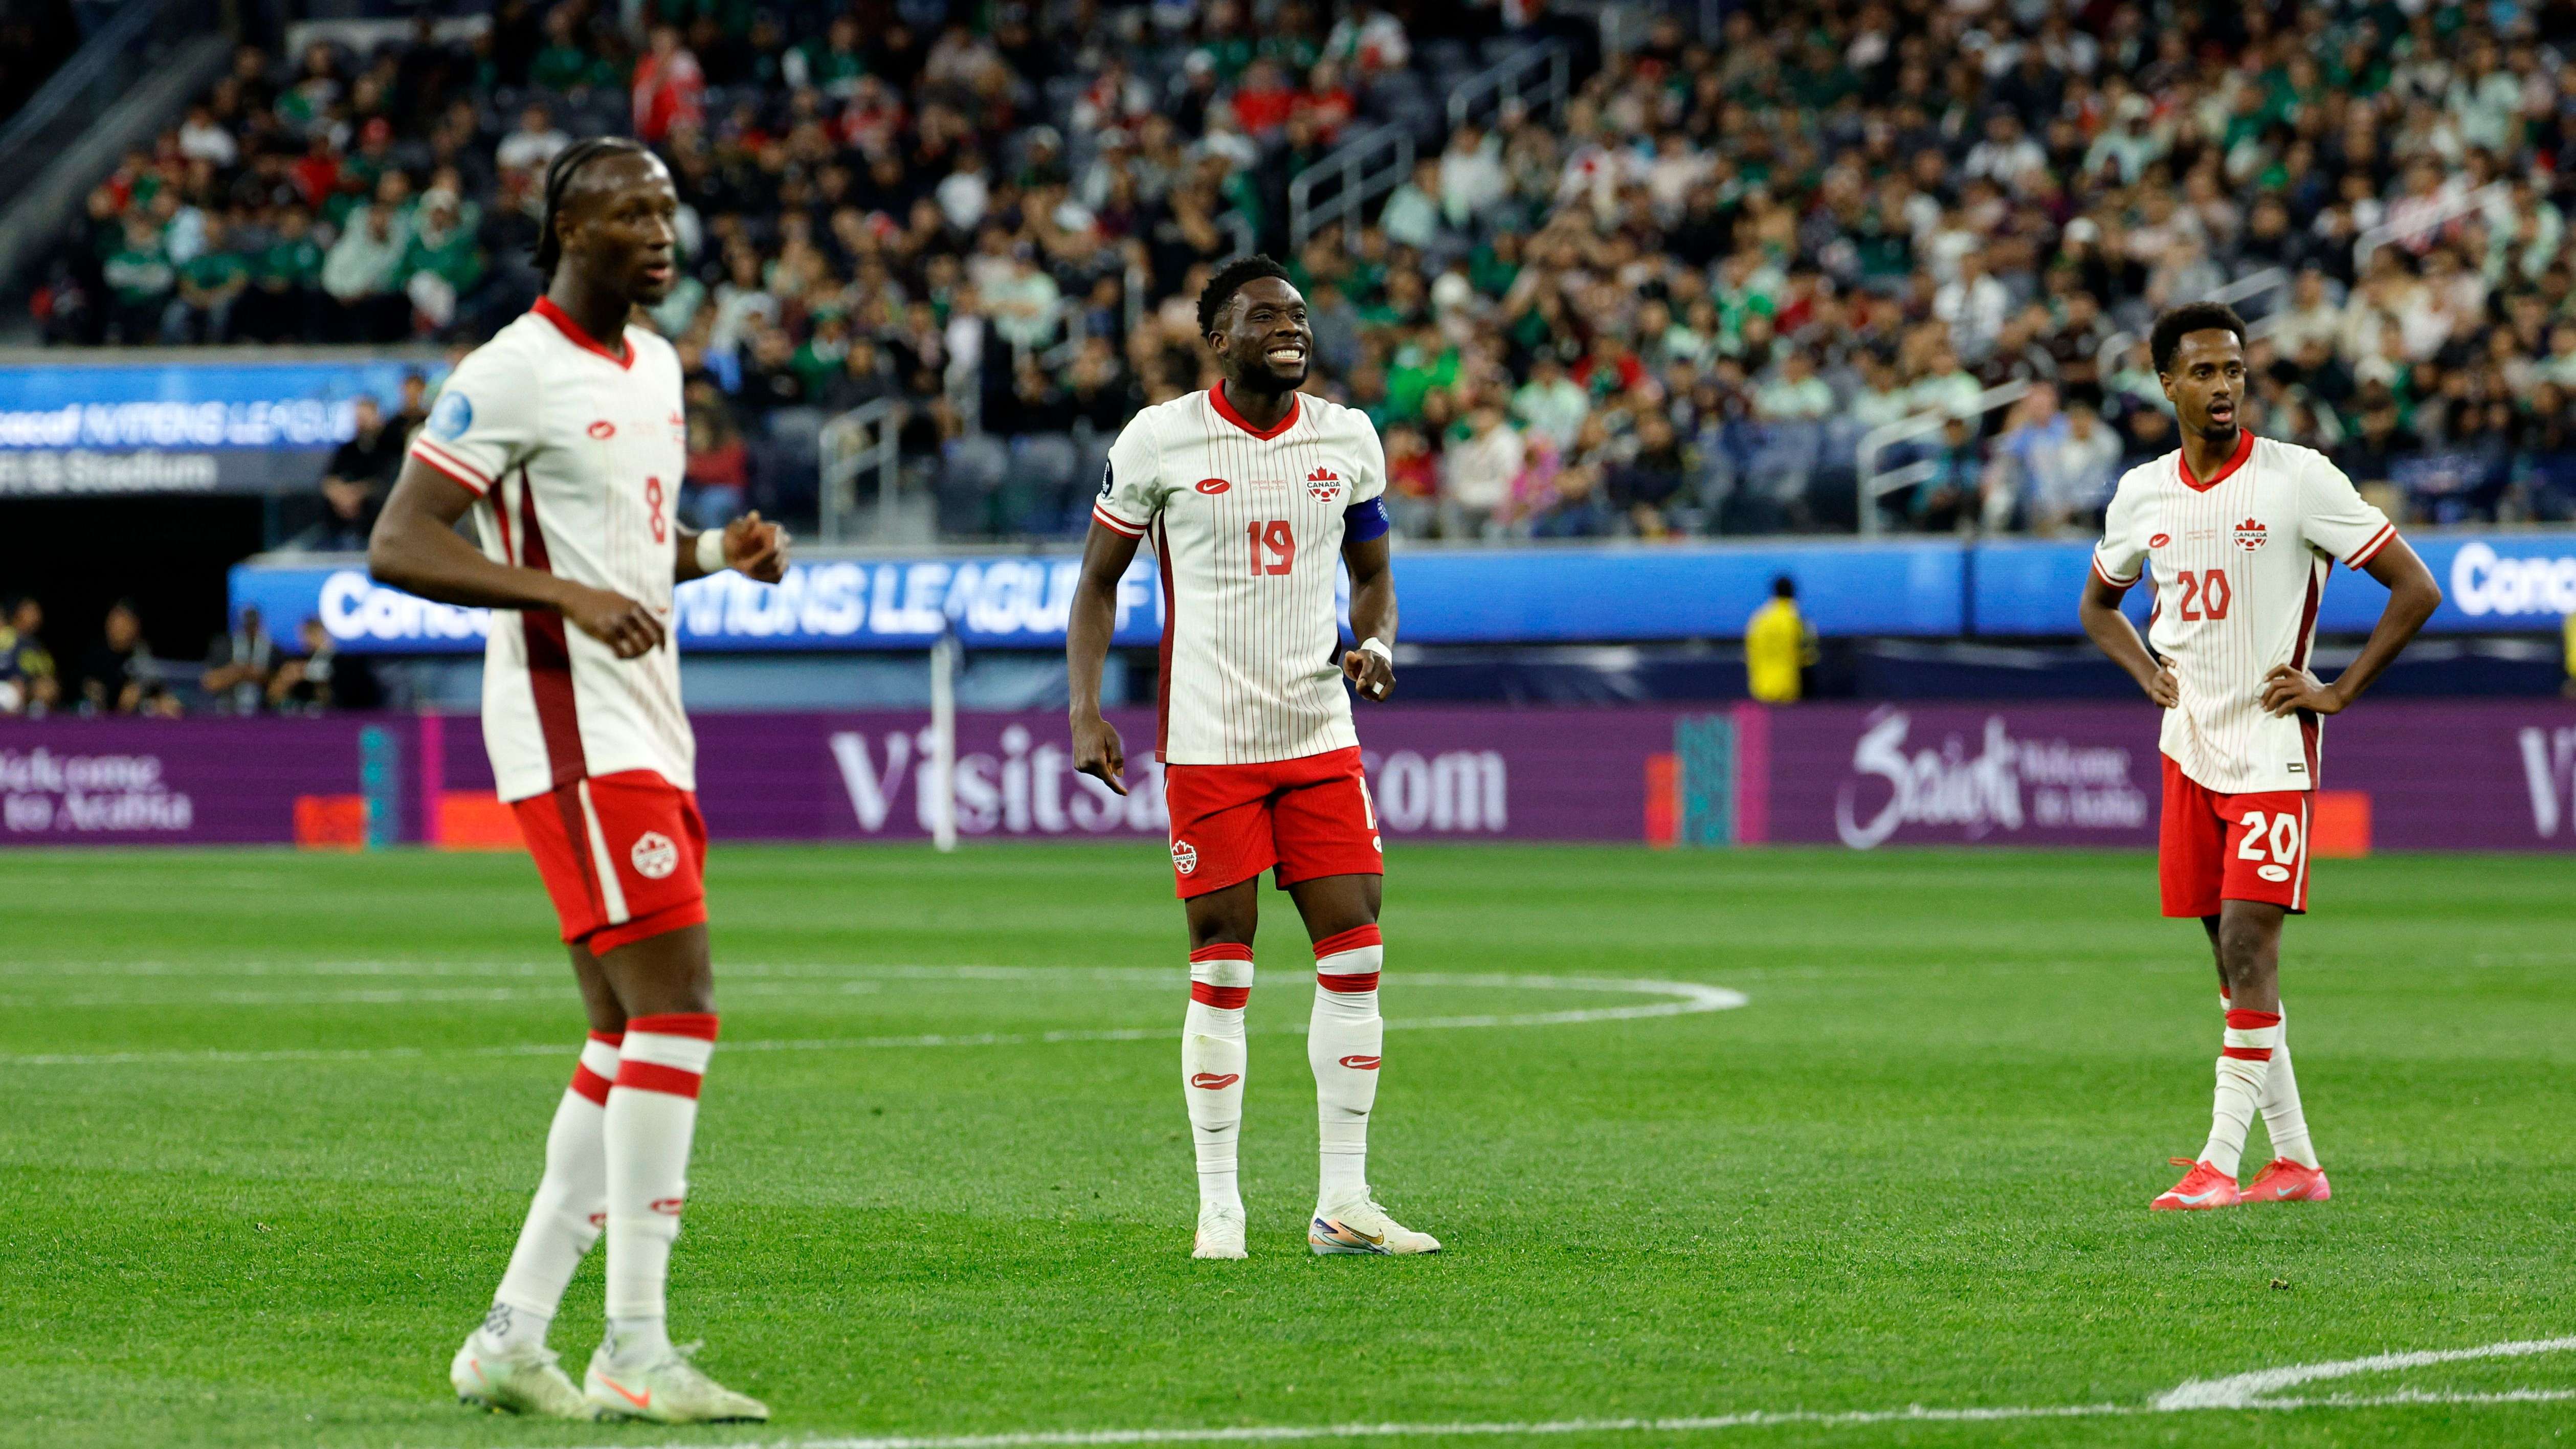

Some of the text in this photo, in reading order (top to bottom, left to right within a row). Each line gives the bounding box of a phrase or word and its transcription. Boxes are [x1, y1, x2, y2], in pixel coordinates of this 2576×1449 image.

[646, 476, 665, 544] 8
[1247, 520, 1296, 576] 19
[2178, 569, 2231, 621] 20
[1359, 776, 1379, 831] 1
[2237, 810, 2300, 865] 20
